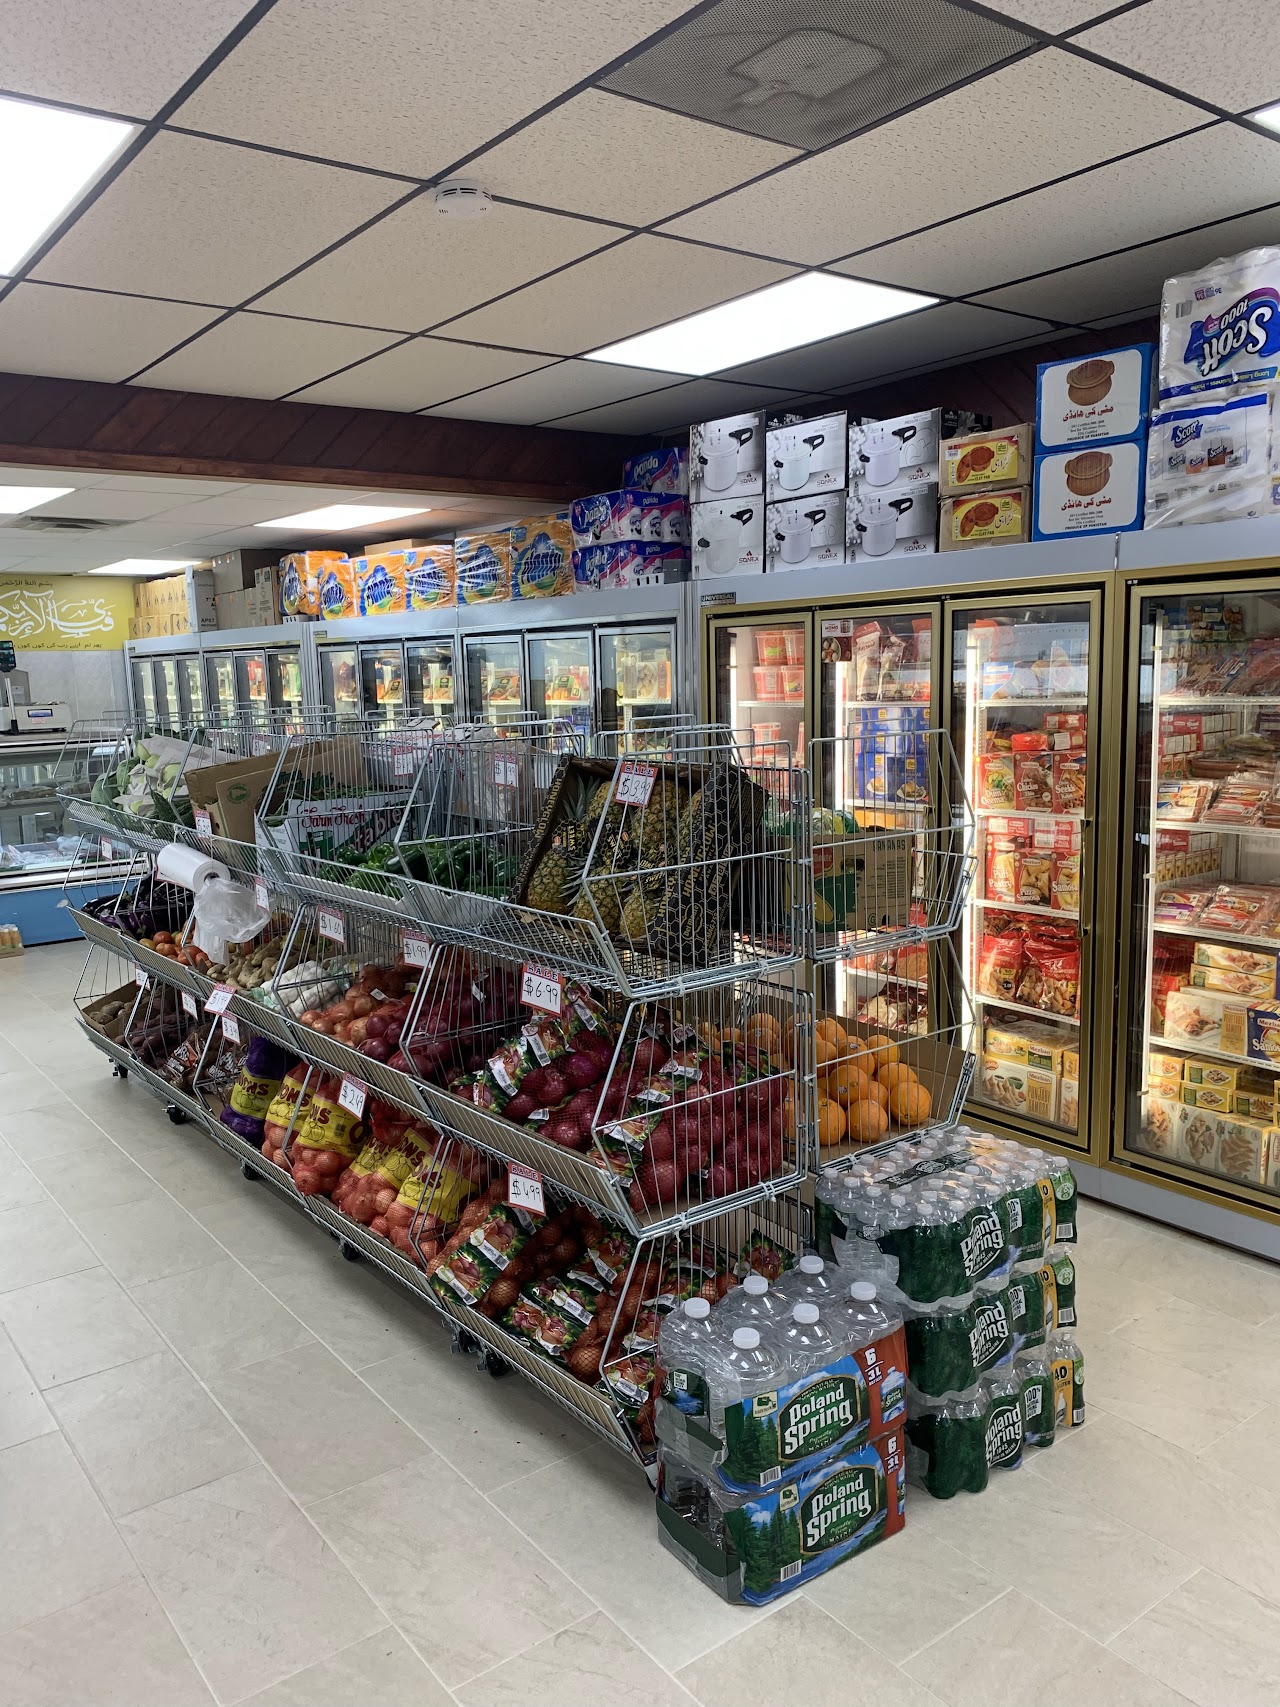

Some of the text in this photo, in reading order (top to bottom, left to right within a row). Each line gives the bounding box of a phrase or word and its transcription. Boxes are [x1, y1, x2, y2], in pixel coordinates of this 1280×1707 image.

[1219, 299, 1249, 330] 1000
[1201, 306, 1273, 377] Scott
[1175, 420, 1200, 442] Scott
[633, 456, 659, 478] panda
[701, 592, 735, 602] UNIVERSAL
[625, 764, 654, 776] SALE
[302, 804, 367, 829] Farm Fresh
[567, 824, 576, 851] SWEET
[988, 878, 1012, 889] Pastry
[404, 940, 428, 959] $1.99
[528, 963, 559, 981] SALE
[523, 976, 559, 1006] $6.99
[1258, 1019, 1280, 1028] Mezba
[1029, 1044, 1051, 1055] Mezban
[1252, 1038, 1280, 1052] Samos
[1028, 1072, 1051, 1083] Mezban
[512, 1164, 539, 1181] SALE
[864, 1347, 878, 1366] 6
[867, 1365, 883, 1382] 3L
[1054, 1365, 1068, 1381] 40
[789, 1382, 845, 1426] Poland
[1026, 1386, 1041, 1404] 100%
[784, 1399, 854, 1455] Spring
[888, 1436, 897, 1454] 6
[887, 1456, 900, 1470] 3L
[811, 1472, 864, 1518] Poland
[806, 1489, 872, 1547] Spring
